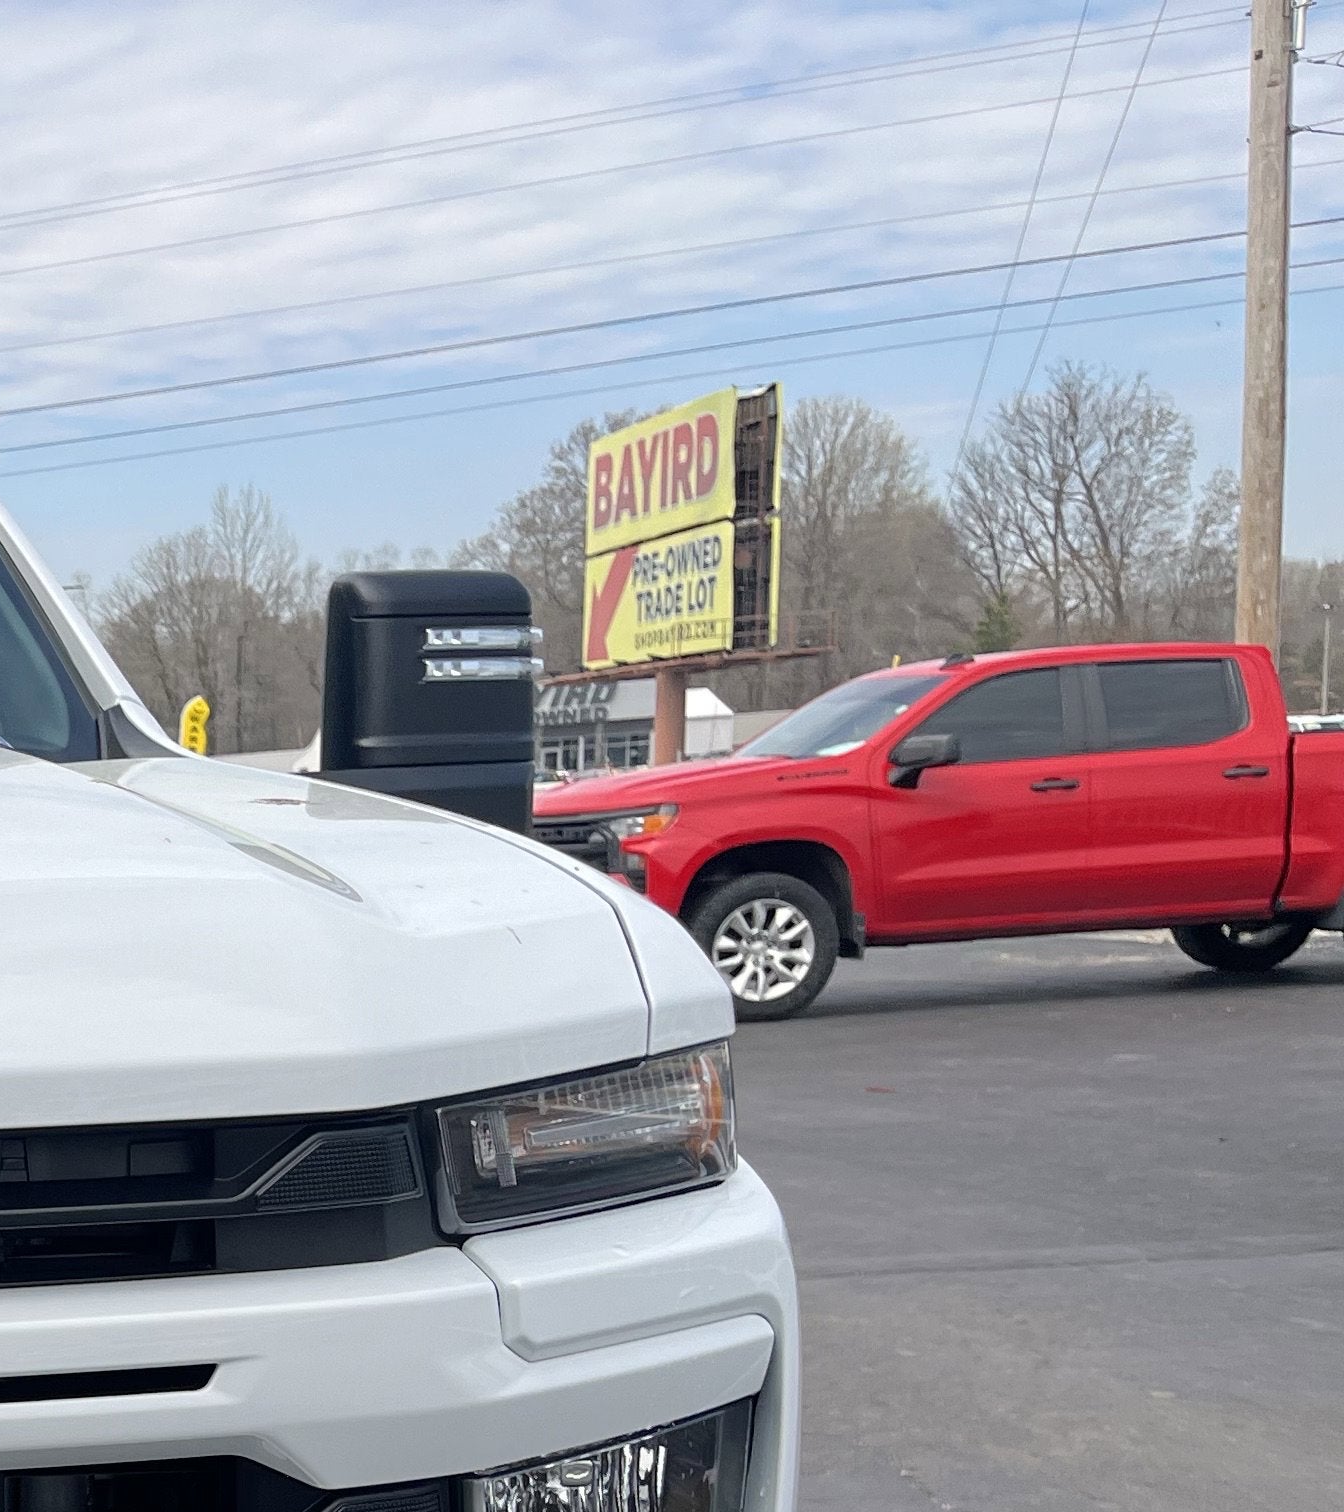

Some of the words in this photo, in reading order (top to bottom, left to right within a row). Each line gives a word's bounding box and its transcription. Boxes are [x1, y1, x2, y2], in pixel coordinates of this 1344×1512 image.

[593, 413, 720, 530] BAYIRD
[632, 536, 722, 588] PRE-OWNED
[636, 585, 683, 626] TRADE
[686, 576, 717, 614] LOT
[533, 681, 615, 712] YIRD
